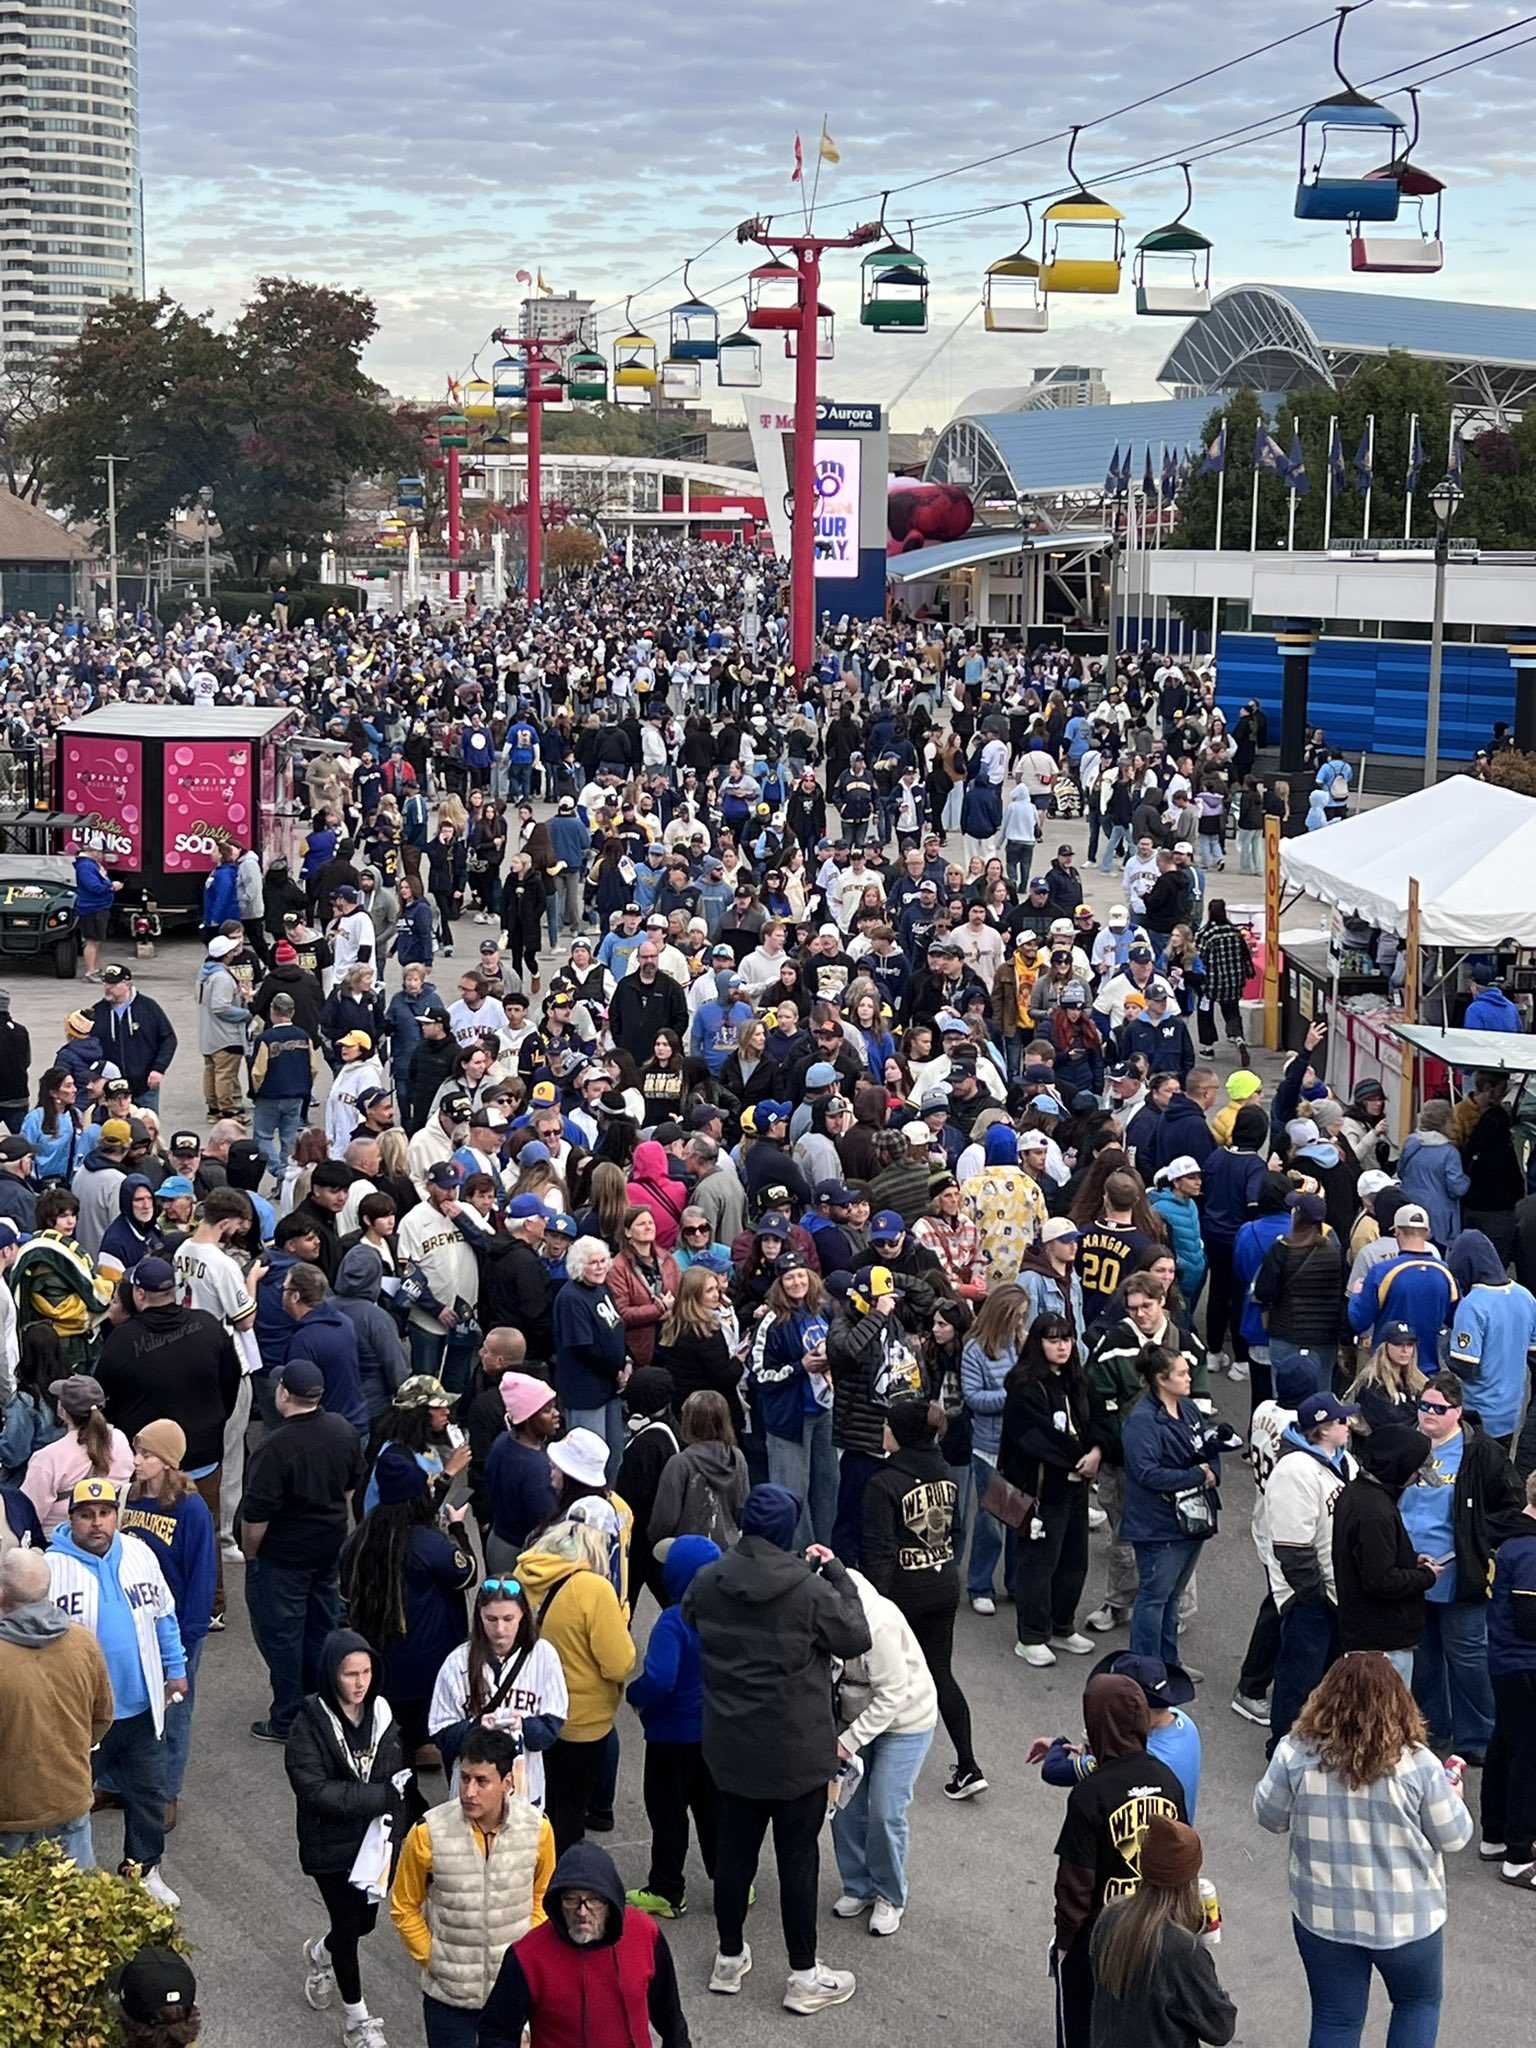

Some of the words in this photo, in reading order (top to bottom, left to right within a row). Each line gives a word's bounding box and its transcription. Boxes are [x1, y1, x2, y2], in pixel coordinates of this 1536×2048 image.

[828, 406, 873, 420] Aurora
[174, 833, 216, 855] SOD
[191, 820, 232, 842] Dirty
[1082, 1252, 1121, 1294] 20
[903, 1490, 924, 1521] WE
[1111, 1803, 1133, 1839] WE
